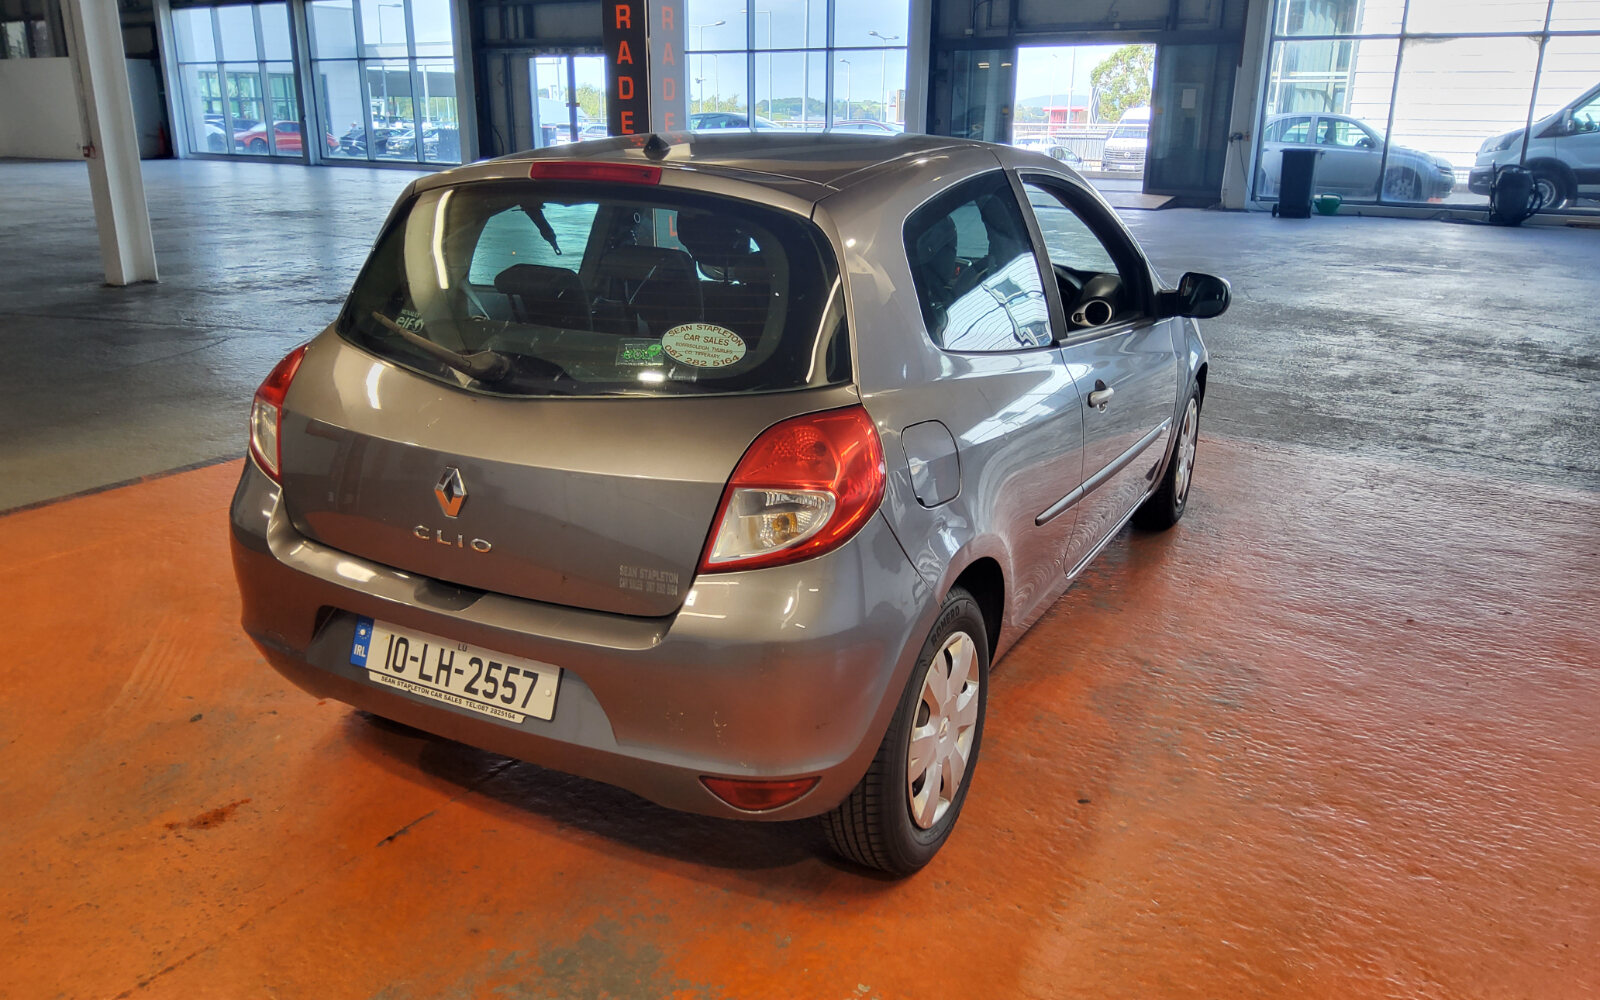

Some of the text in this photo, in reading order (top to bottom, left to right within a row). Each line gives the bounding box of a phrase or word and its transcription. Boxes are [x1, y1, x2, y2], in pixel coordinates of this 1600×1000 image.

[668, 324, 743, 347] SEAN STAPLETON
[683, 333, 729, 347] CAR SALES
[664, 344, 740, 366] 087 282 5164
[413, 525, 492, 553] CLIO
[353, 643, 367, 659] IRL
[384, 633, 539, 709] 10-LH-2557
[381, 675, 396, 685] SEAN
[396, 681, 430, 695] STAPLETON
[430, 690, 443, 699] CAR
[443, 694, 463, 705] SALES
